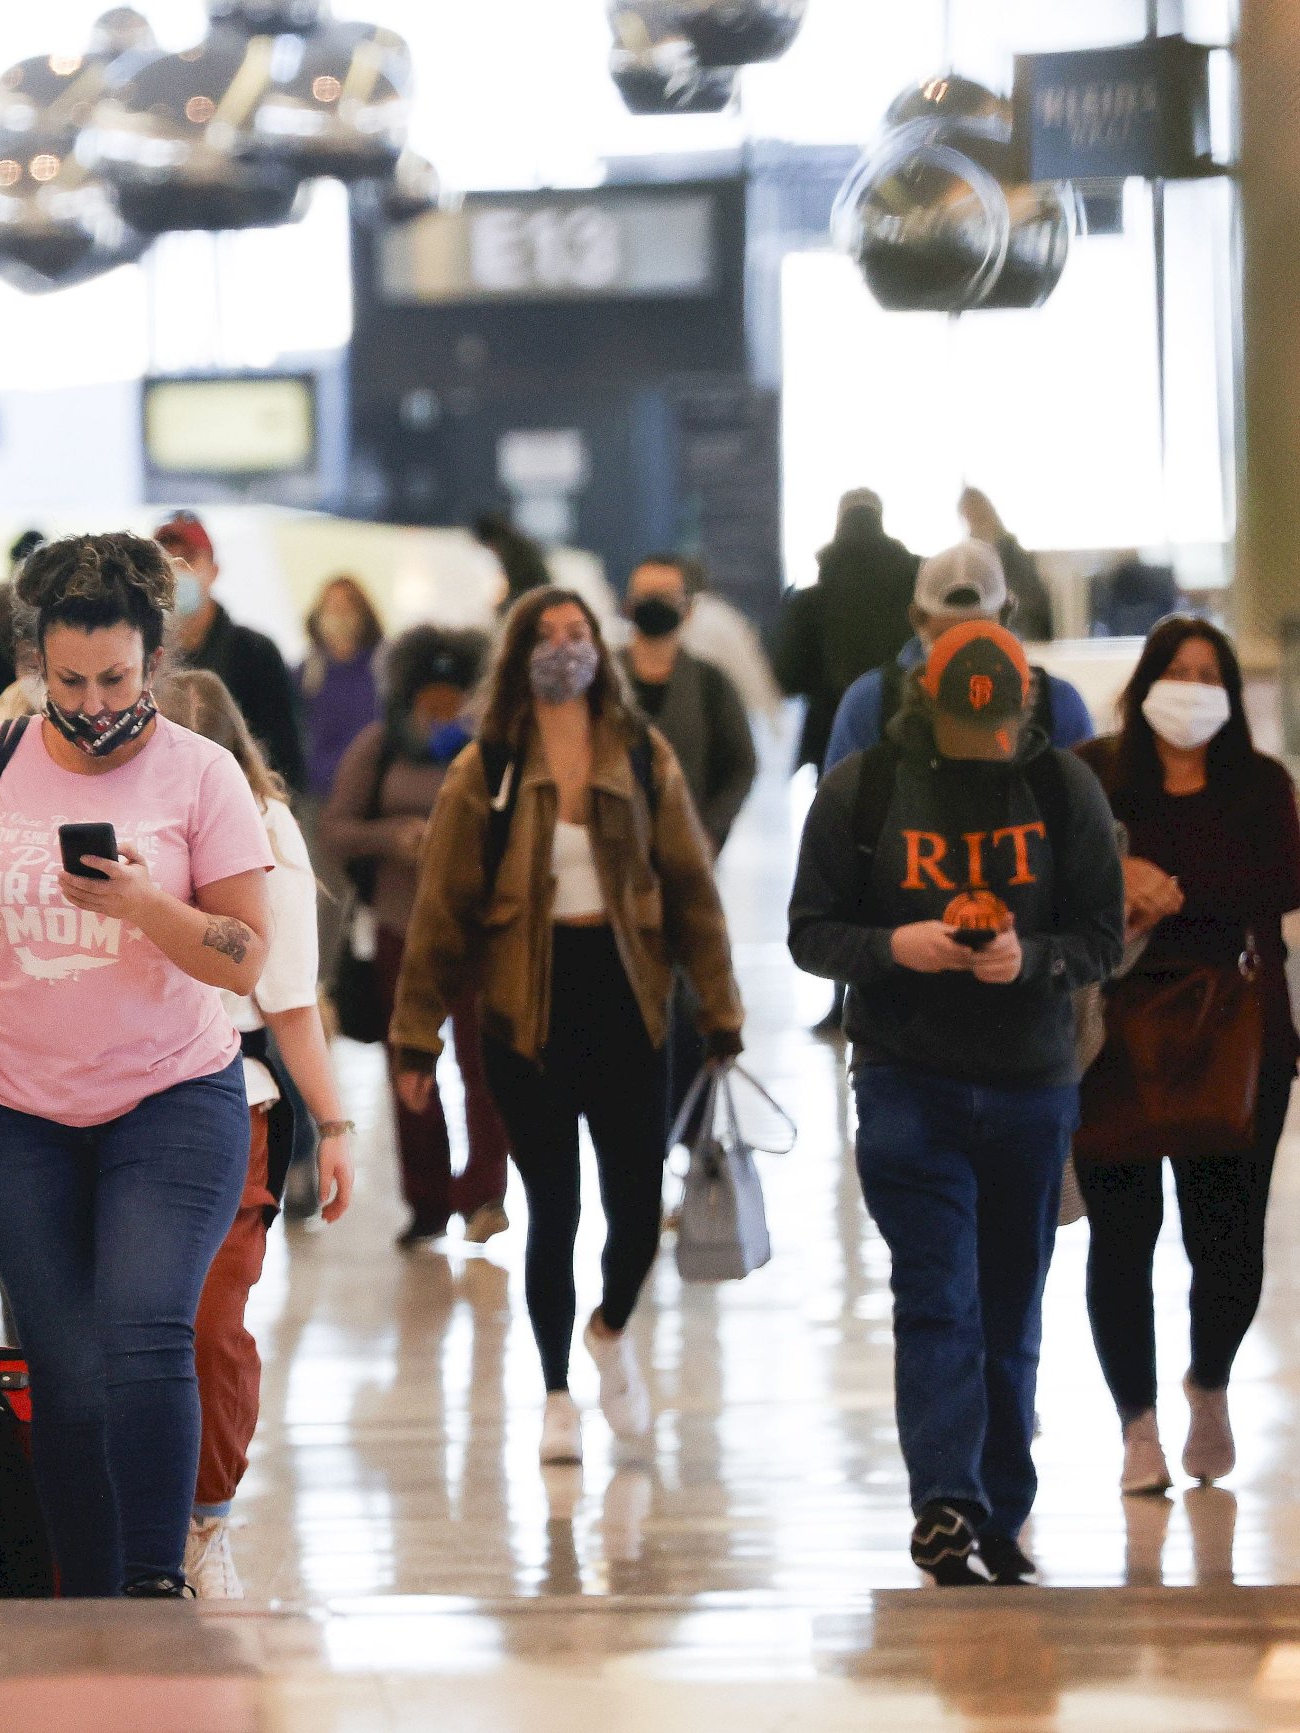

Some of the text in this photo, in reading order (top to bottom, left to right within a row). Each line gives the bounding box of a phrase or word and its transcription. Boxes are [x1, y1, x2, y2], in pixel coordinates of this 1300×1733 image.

[470, 207, 618, 290] E13
[900, 820, 1047, 890] RIT
[0, 905, 123, 956] MOM
